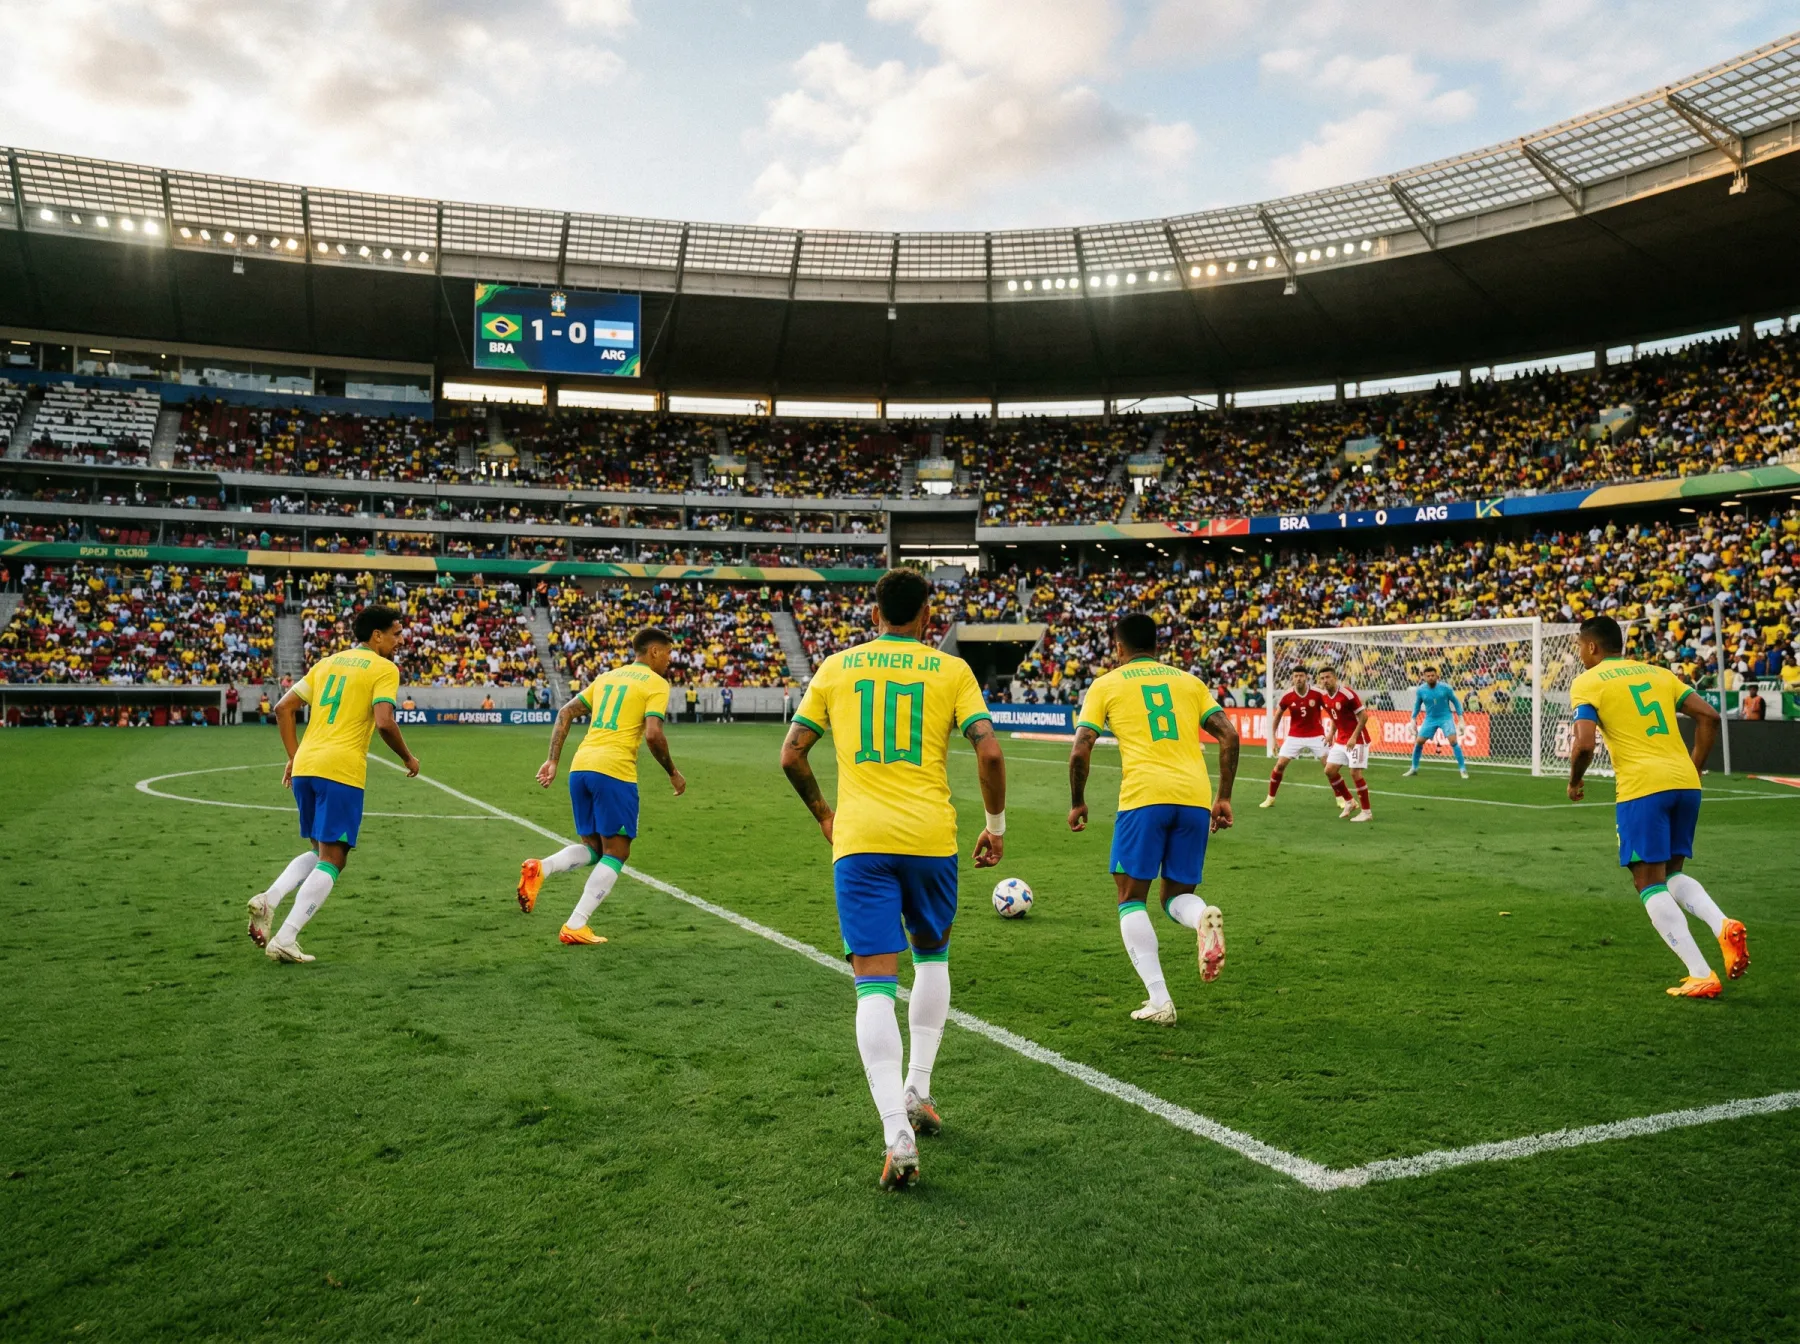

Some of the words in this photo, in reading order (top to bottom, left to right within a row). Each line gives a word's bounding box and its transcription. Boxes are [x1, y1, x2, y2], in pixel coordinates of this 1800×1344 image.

[531, 319, 543, 341] 1
[568, 322, 587, 344] 0
[489, 342, 514, 354] BRA
[601, 350, 626, 361] ARG
[1279, 516, 1310, 531] BRA
[1338, 513, 1347, 527] 1
[1375, 510, 1387, 525] 0
[1415, 506, 1448, 521] ARG
[917, 656, 941, 672] JR
[319, 674, 347, 724] 4
[592, 684, 628, 731] 11
[1628, 682, 1669, 737] 5
[396, 711, 427, 723] FISA
[855, 679, 924, 766] 10
[1141, 683, 1179, 742] 8
